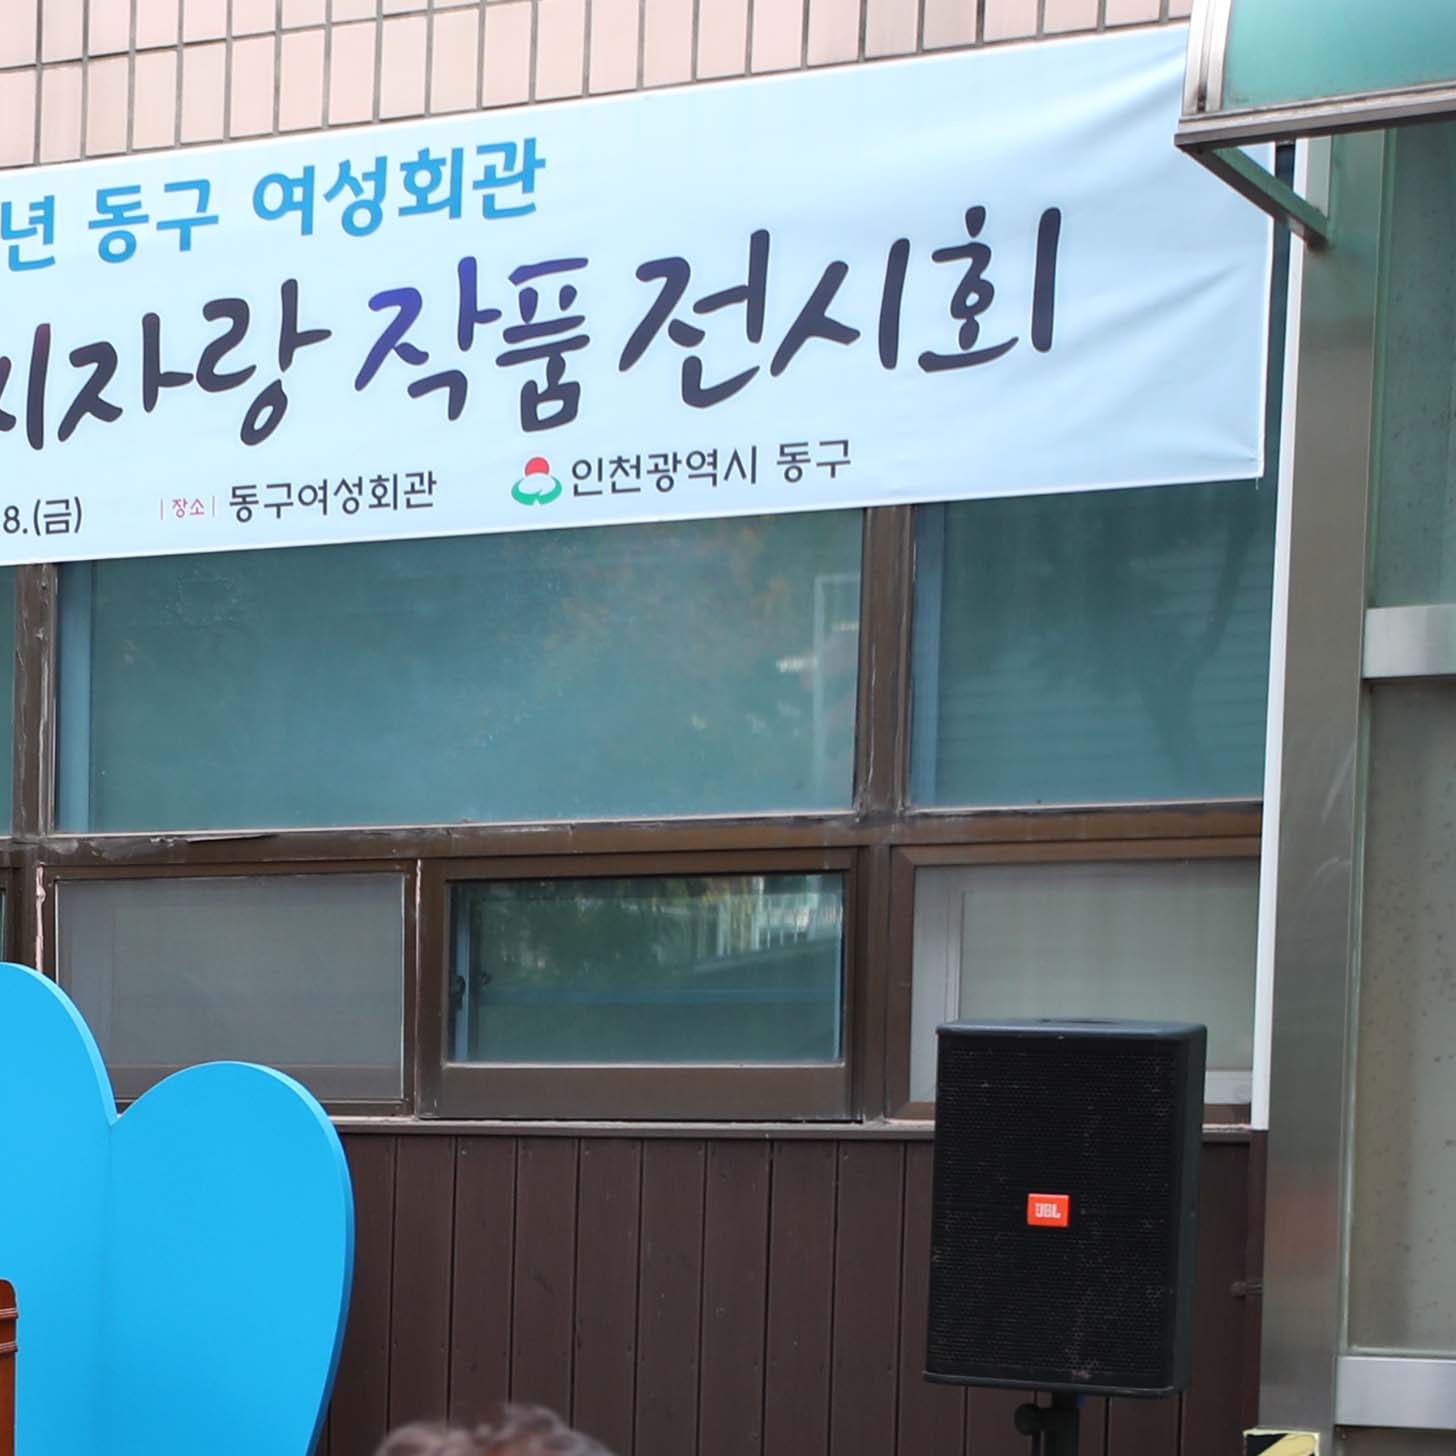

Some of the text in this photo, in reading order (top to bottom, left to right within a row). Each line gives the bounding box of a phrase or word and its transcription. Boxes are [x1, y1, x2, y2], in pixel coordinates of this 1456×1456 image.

[88, 179, 219, 263] 동구
[253, 138, 546, 237] 여성회관
[355, 258, 590, 432] 작품
[619, 206, 1061, 408] 전시회
[572, 440, 850, 496] 인천광역시 동구
[172, 471, 437, 522] 장소 동구여성회관
[1035, 1203, 1062, 1219] JBL
